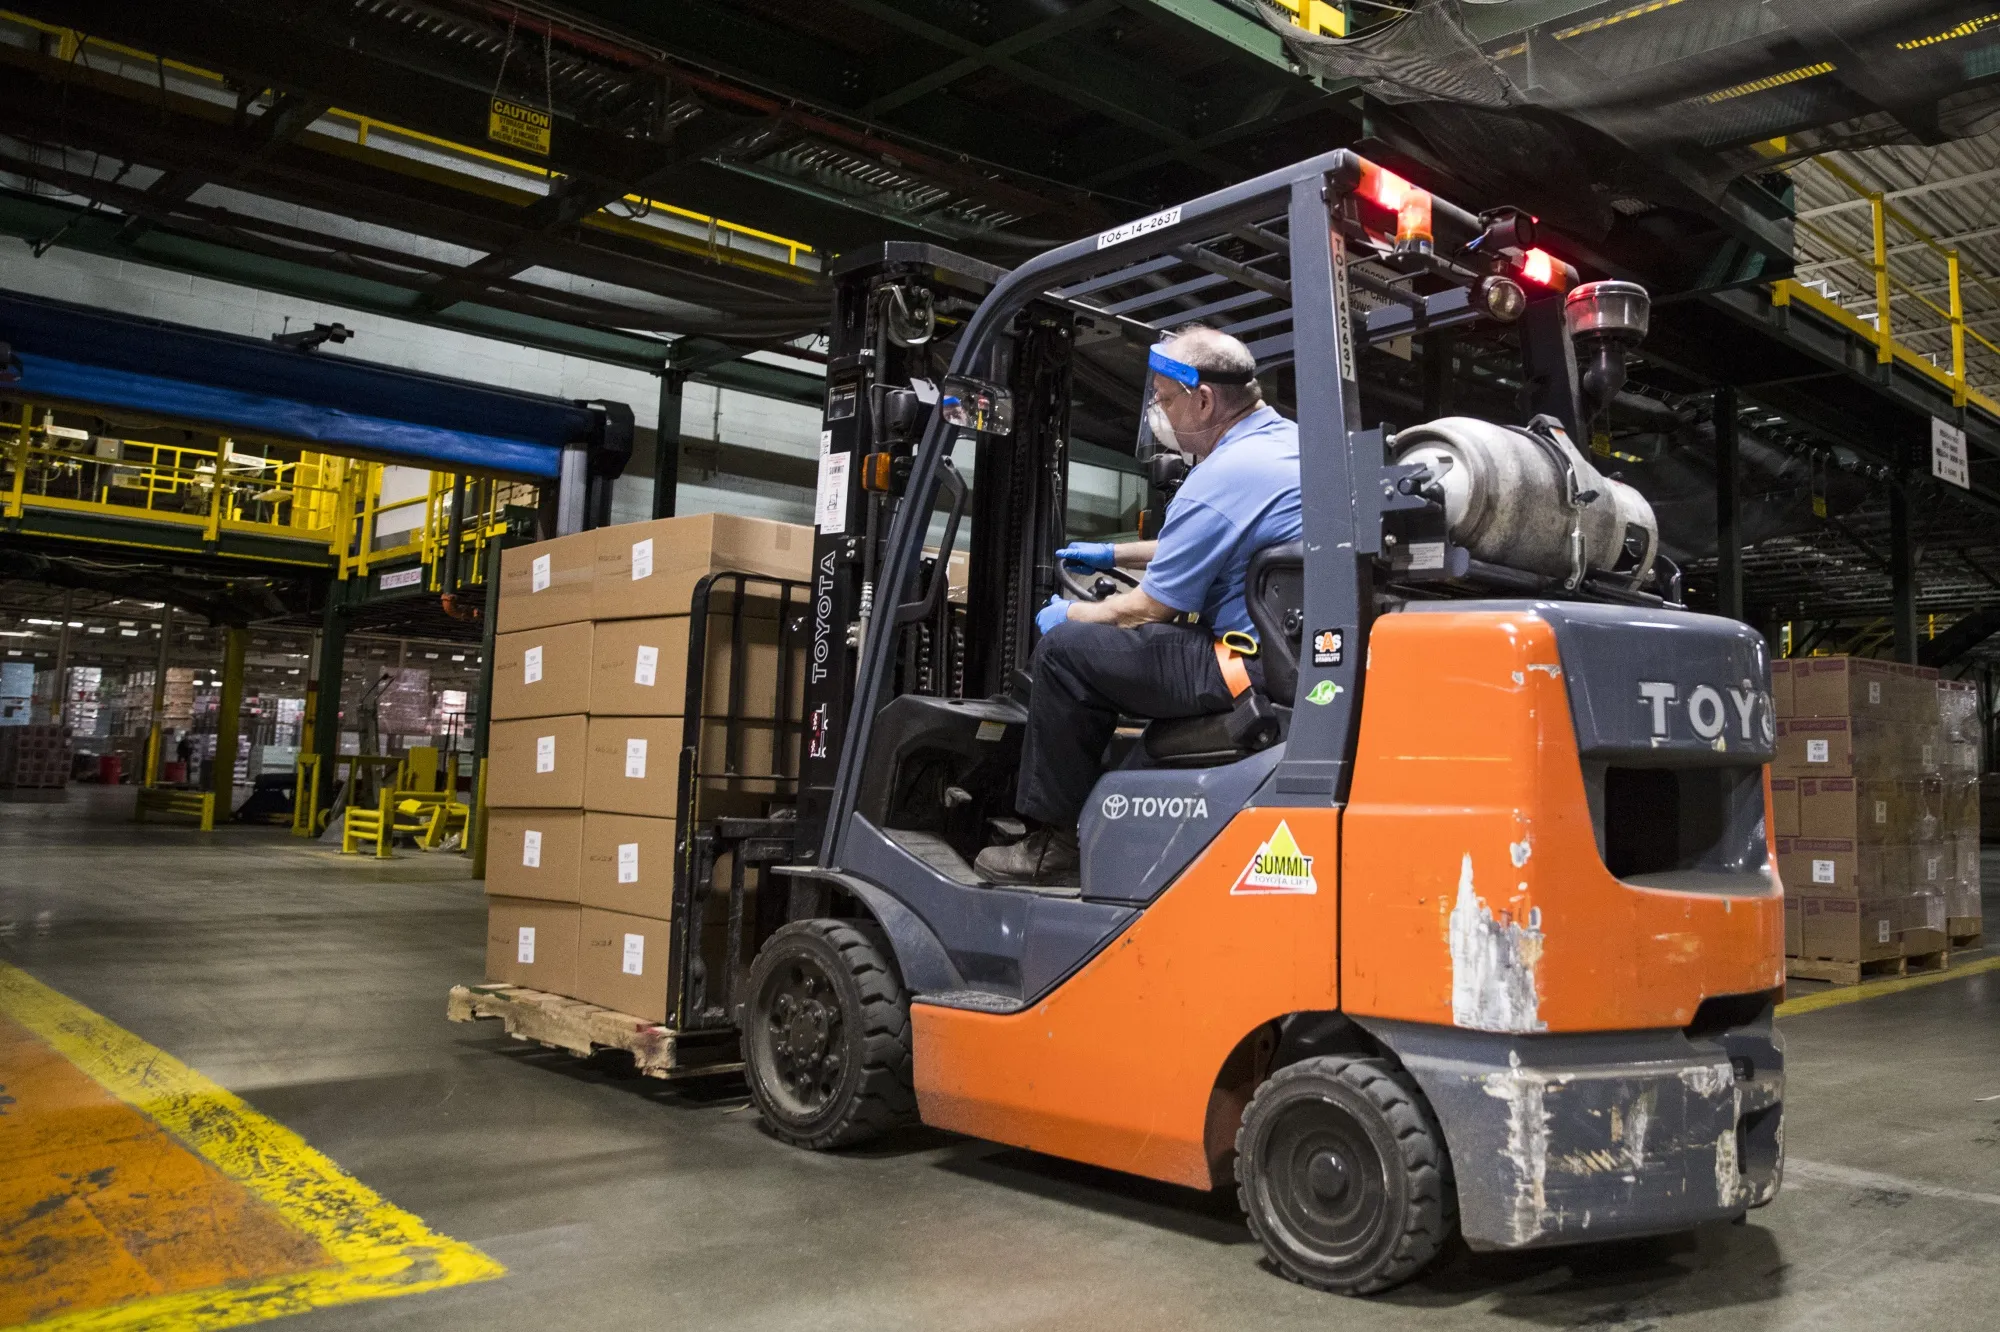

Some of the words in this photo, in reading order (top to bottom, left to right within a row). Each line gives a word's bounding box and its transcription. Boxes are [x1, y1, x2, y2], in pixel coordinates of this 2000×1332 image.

[494, 101, 549, 128] CAUTION
[812, 551, 836, 684] TOYOTA
[1315, 632, 1342, 652] SAS
[1132, 797, 1208, 818] TOYOTA
[1255, 854, 1312, 877] SUMMIT
[1255, 875, 1288, 885] TOYOTA
[1290, 877, 1309, 886] LIFT
